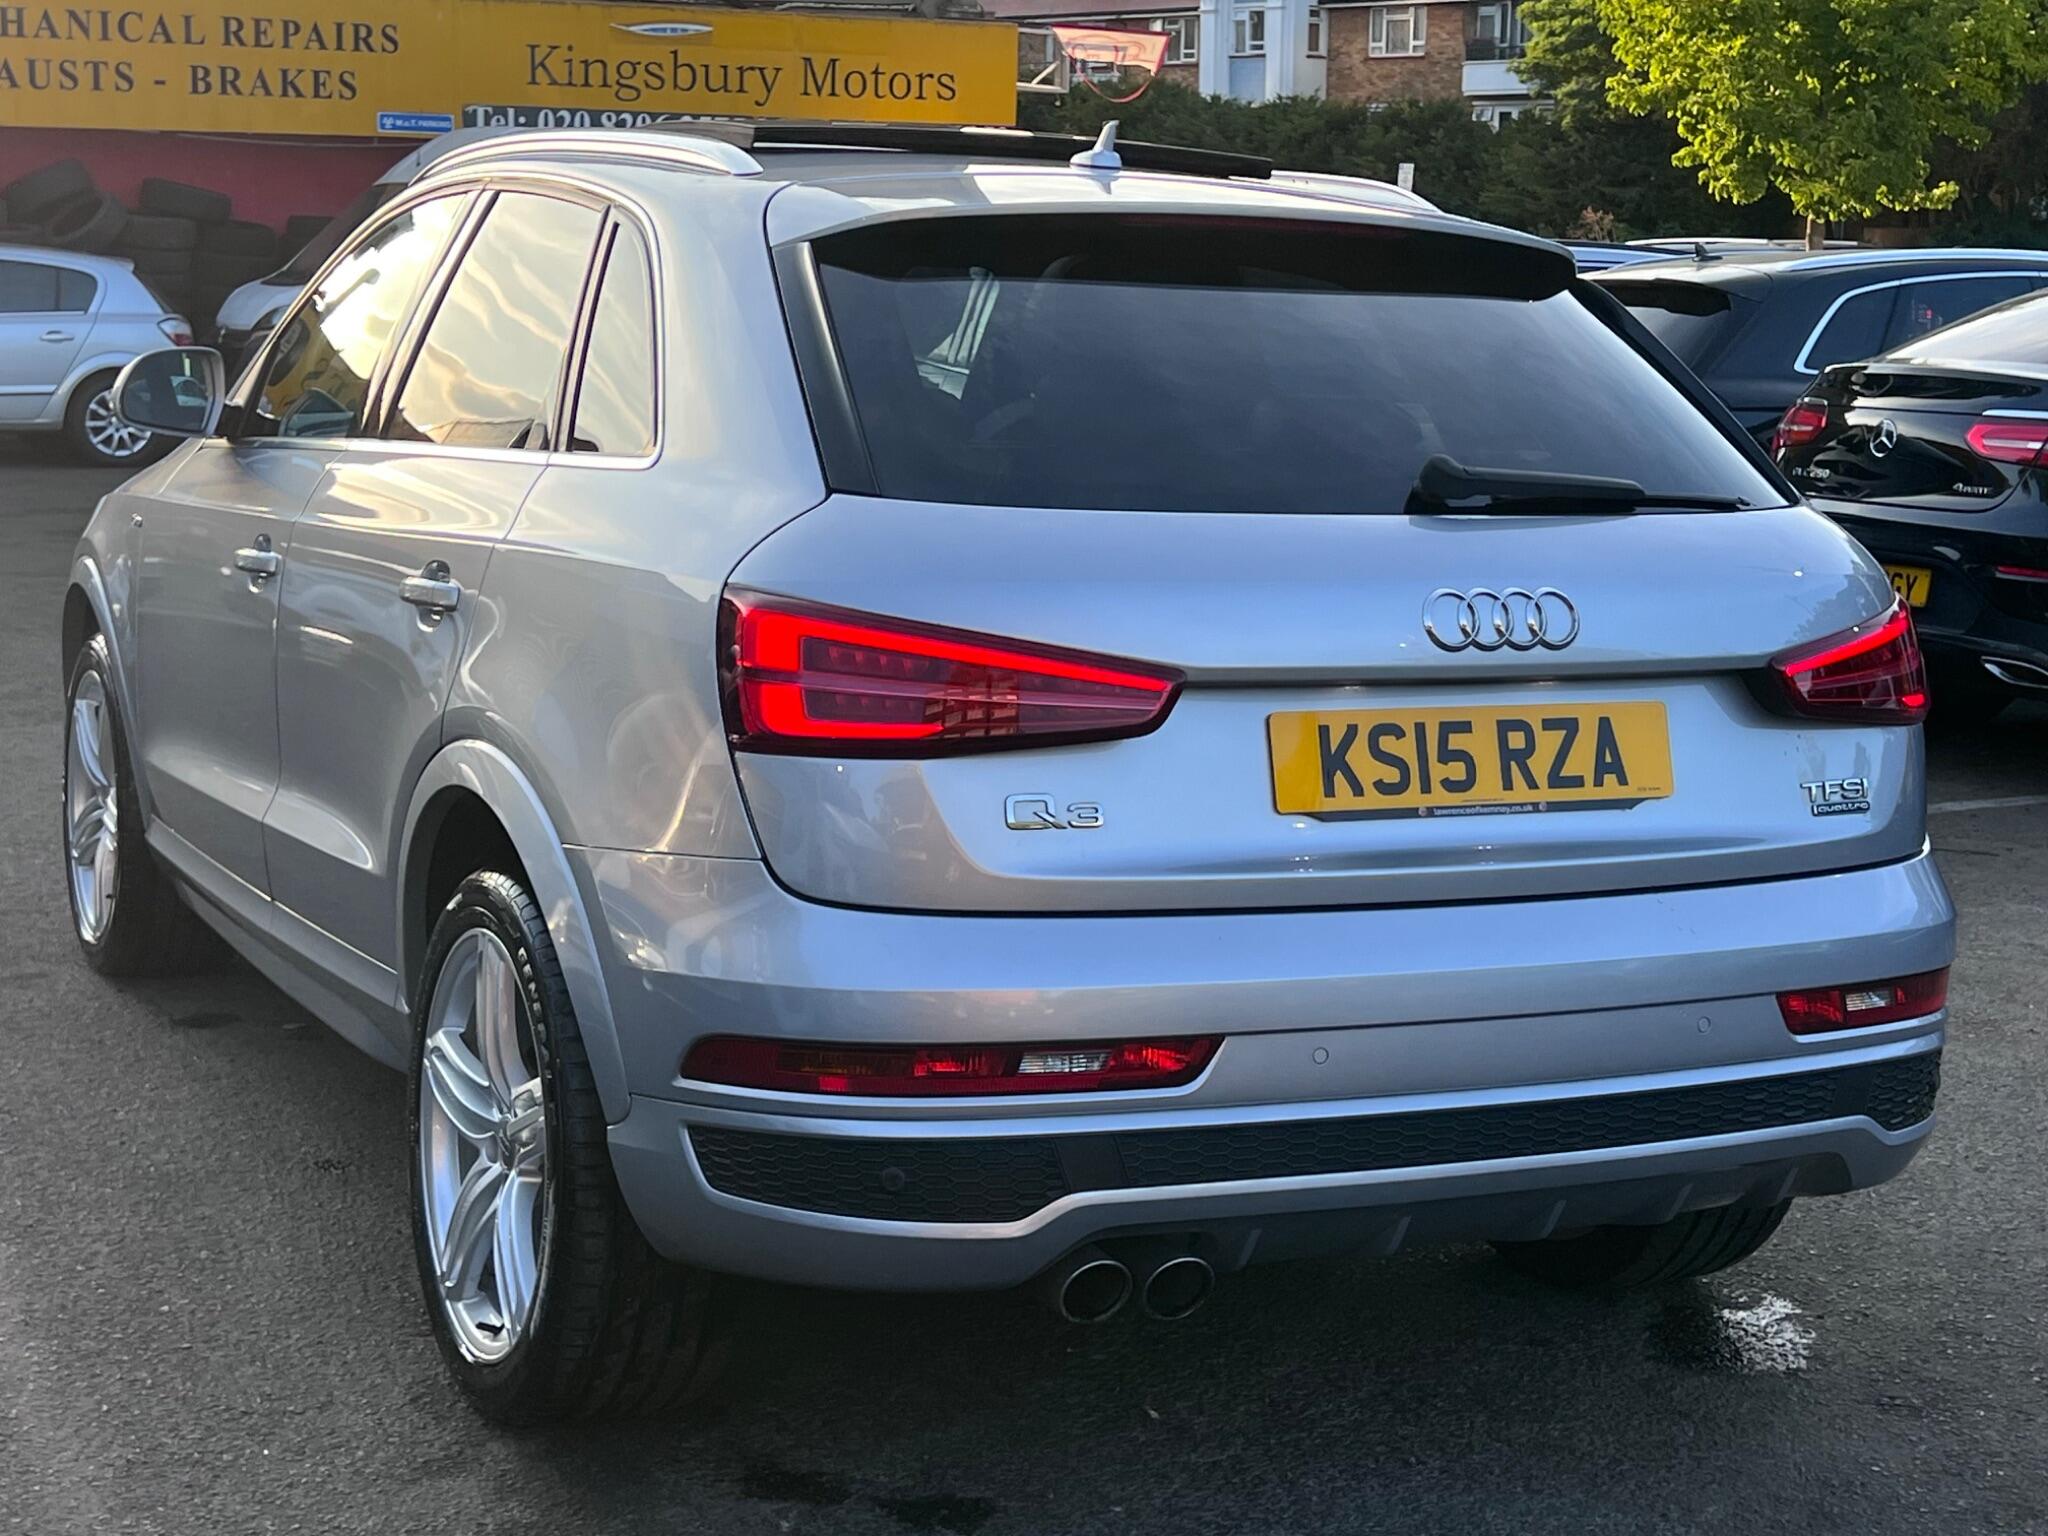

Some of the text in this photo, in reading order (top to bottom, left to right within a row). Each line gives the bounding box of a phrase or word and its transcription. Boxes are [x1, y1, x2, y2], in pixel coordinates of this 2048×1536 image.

[0, 6, 399, 54] HANICAL REPAIRS
[0, 58, 134, 92] AUSTS
[189, 65, 357, 100] BRAKES
[526, 44, 957, 107] Kingsbury Motors
[1318, 716, 1629, 798] KS15 RZA
[1800, 778, 1868, 802] TFSI
[1818, 802, 1869, 813] quattro
[1004, 793, 1104, 830] Q3
